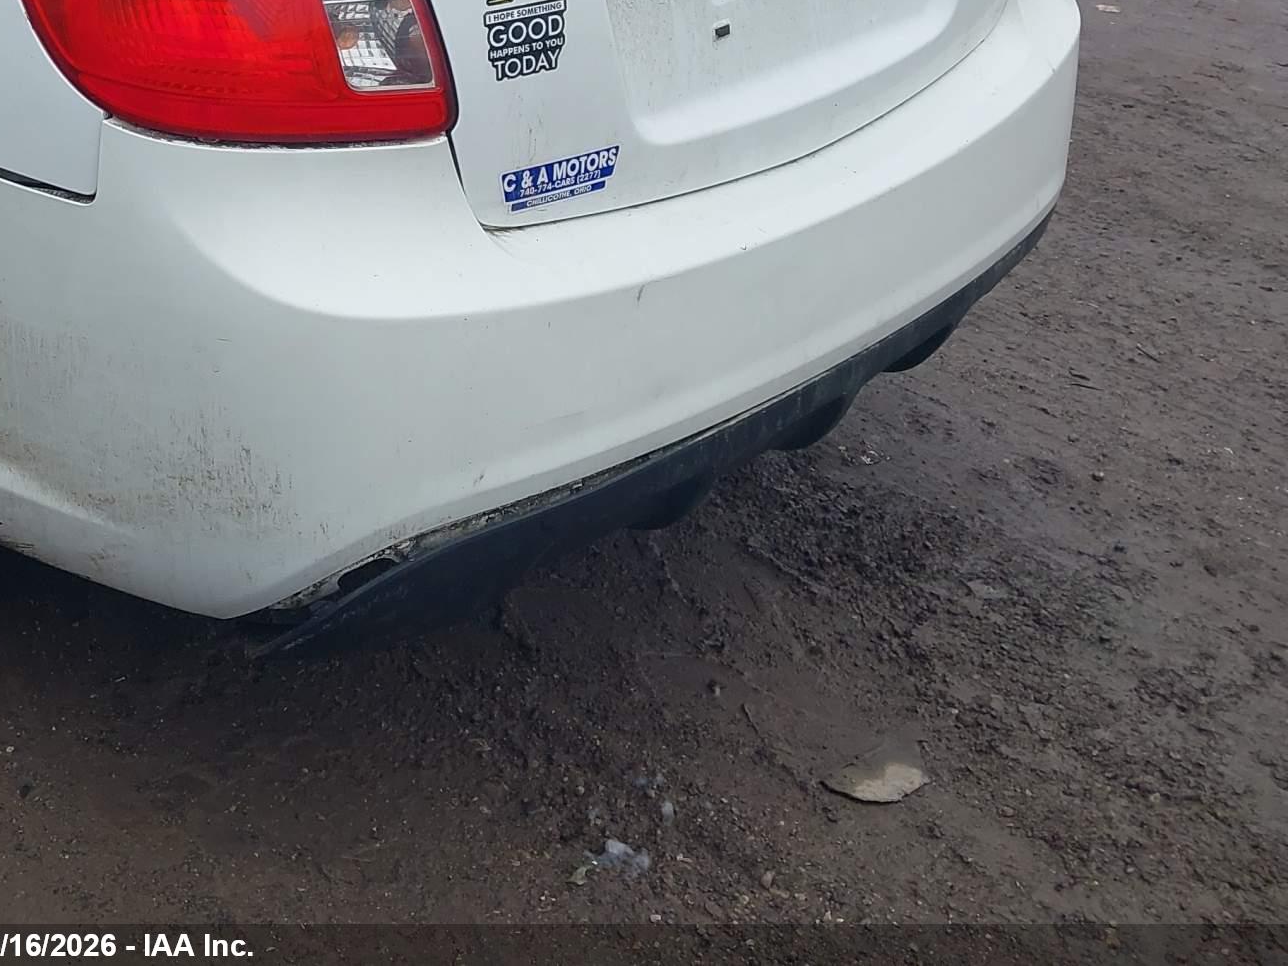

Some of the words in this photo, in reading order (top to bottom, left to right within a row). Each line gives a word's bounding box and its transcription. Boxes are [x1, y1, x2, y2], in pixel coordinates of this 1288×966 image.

[493, 11, 515, 22] HOPE
[516, 1, 563, 18] SOMETHING
[489, 15, 563, 48] GOOD
[490, 44, 530, 59] HAPPENS
[532, 40, 544, 51] TO
[545, 36, 564, 48] YOU
[494, 48, 560, 80] TODAY
[503, 174, 517, 192] C
[521, 170, 534, 189] &
[537, 167, 550, 185] A
[553, 148, 617, 181] MOTORS
[519, 176, 575, 197] 740-774-CARS
